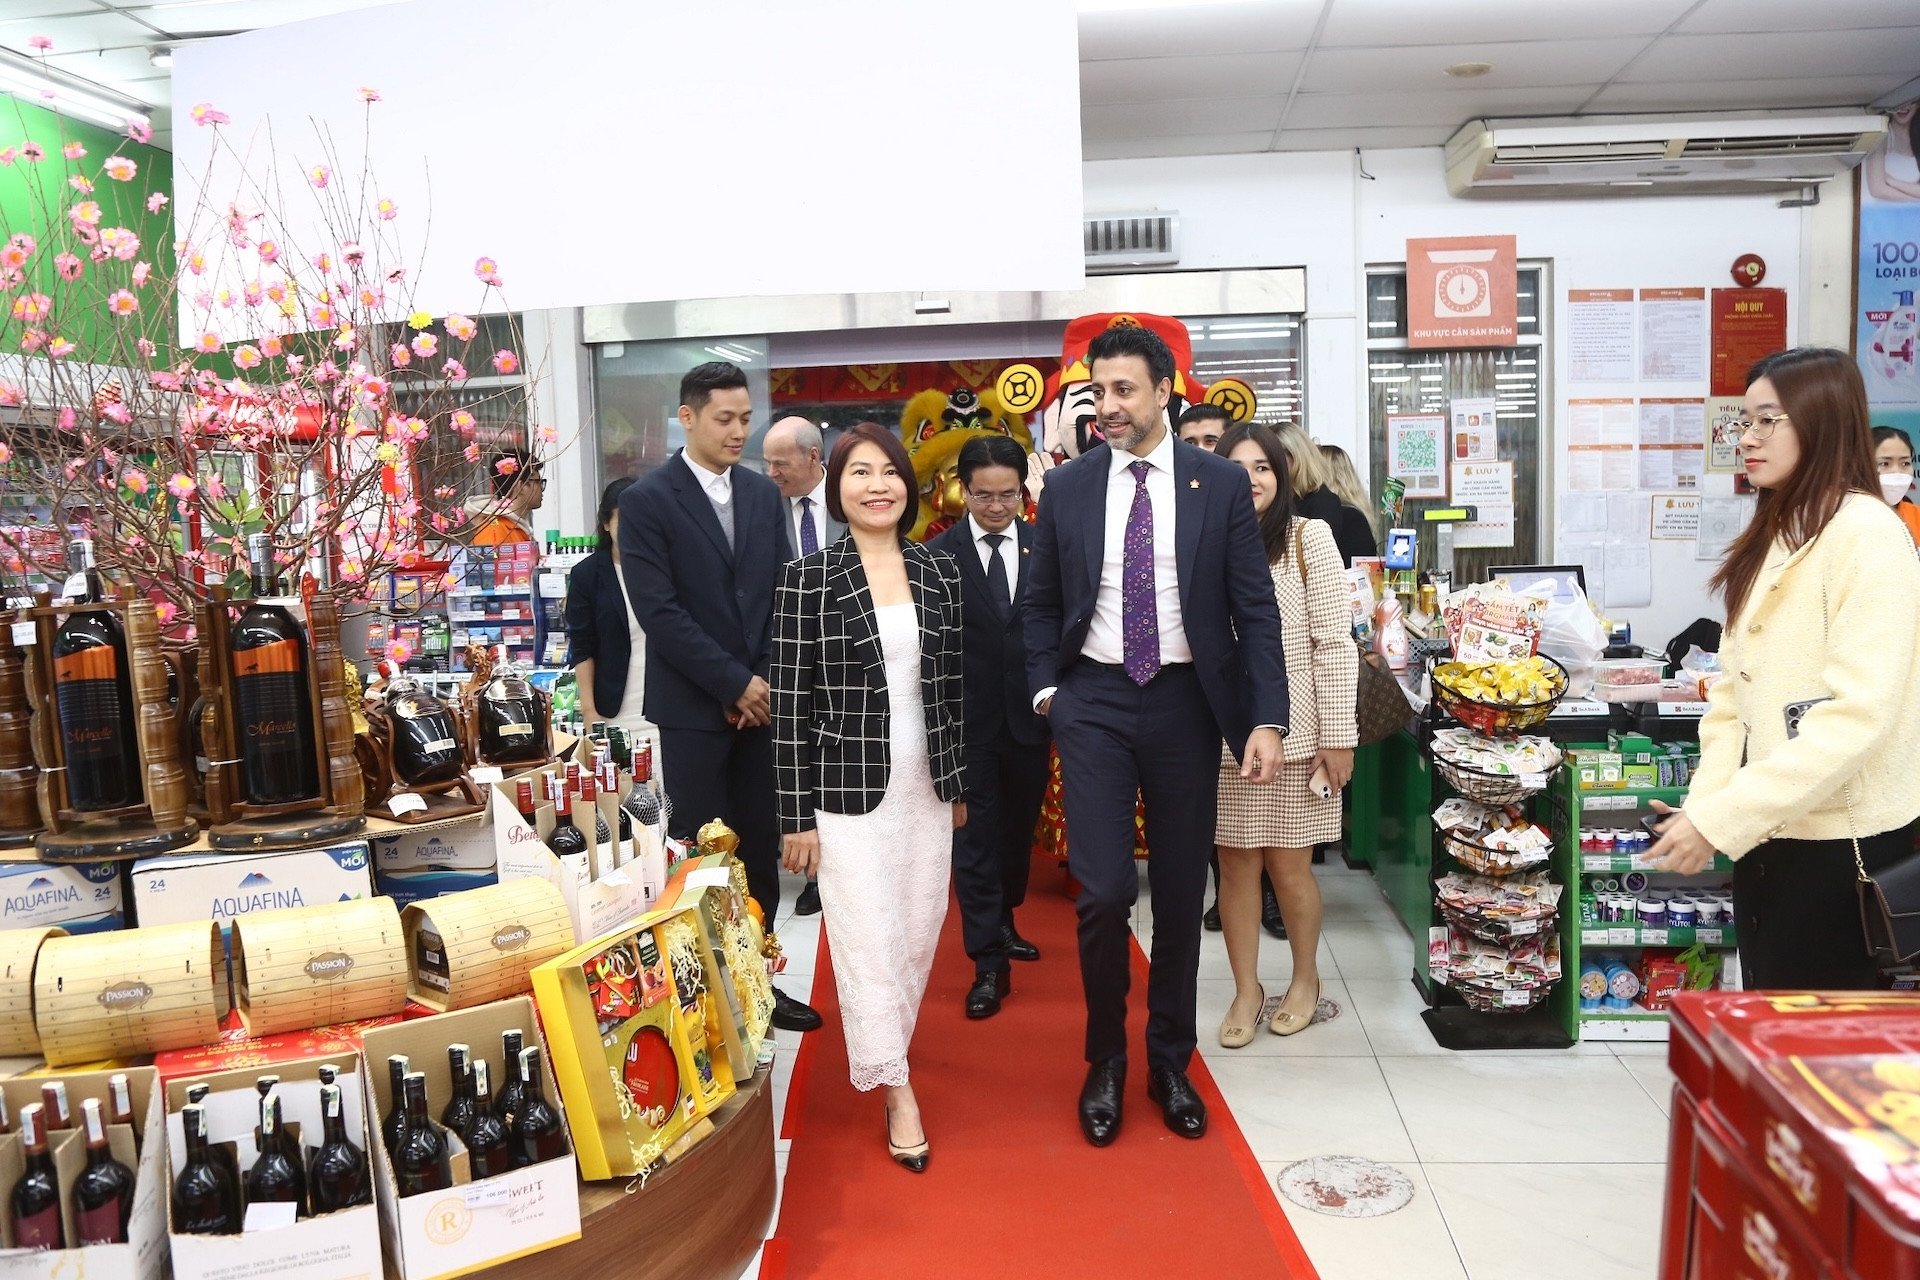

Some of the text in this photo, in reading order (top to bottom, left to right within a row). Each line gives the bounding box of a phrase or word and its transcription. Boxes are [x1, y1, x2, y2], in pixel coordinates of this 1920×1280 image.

[1872, 241, 1920, 265] 100
[1876, 267, 1906, 281] LOẠI
[1735, 301, 1764, 313] NỘI QUY
[1870, 310, 1888, 321] MỚI
[1413, 330, 1431, 338] KHU
[1433, 329, 1450, 338] VỰC
[1451, 328, 1469, 336] CÂN
[1488, 326, 1512, 335] PHẨM
[384, 847, 398, 856] 24
[415, 845, 456, 858] AQUAFINA
[150, 879, 166, 890] 24
[94, 886, 111, 898] 24
[4, 885, 80, 917] AQUAFINA
[211, 887, 304, 919] AQUAFINA
[496, 930, 525, 945] PASSION
[311, 958, 346, 972] PASSION
[106, 988, 144, 1001] PASSION
[440, 1211, 458, 1232] R
